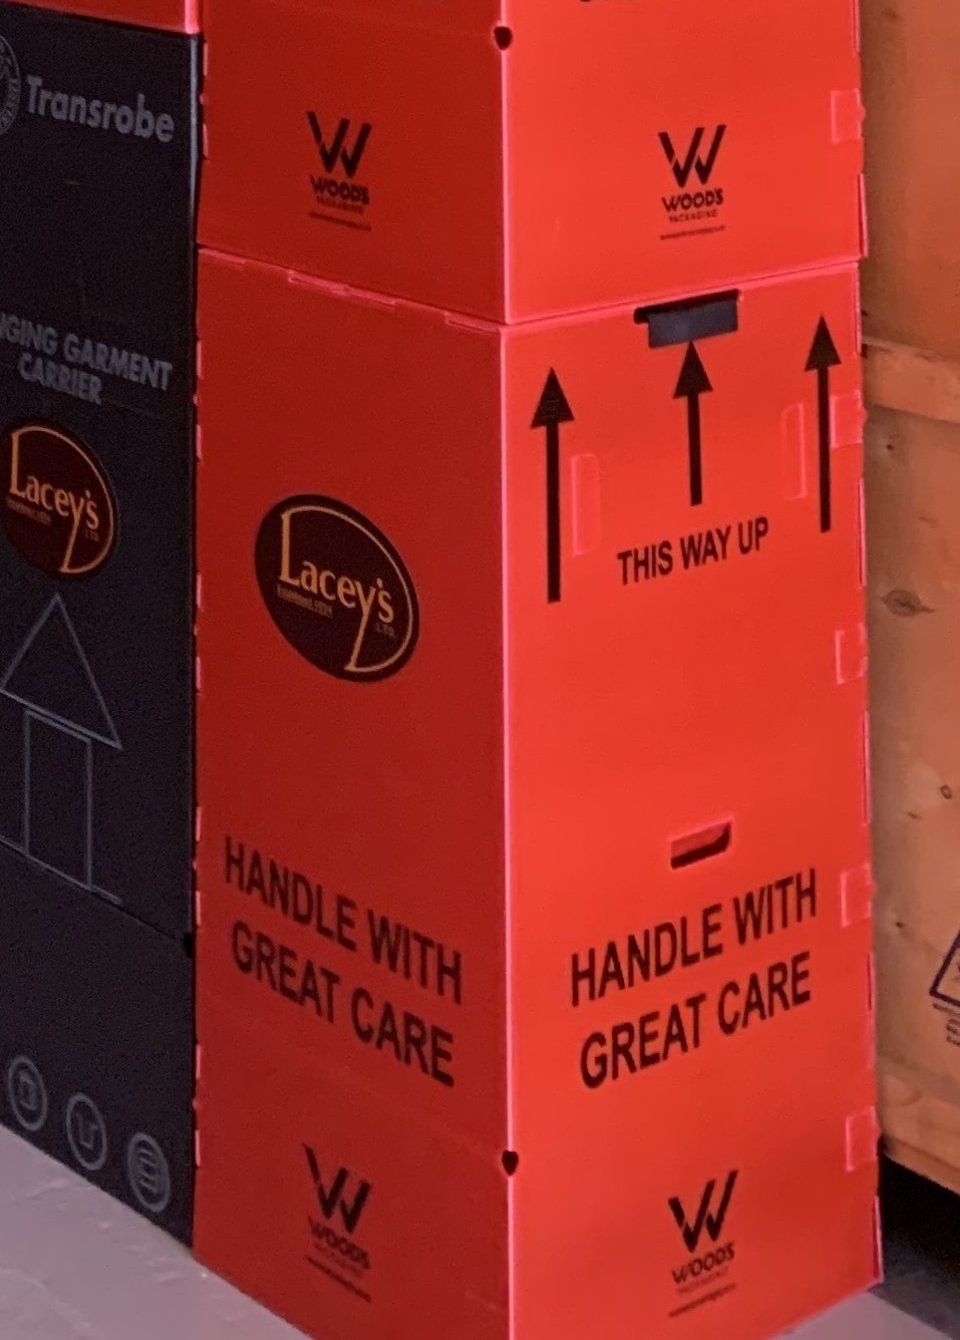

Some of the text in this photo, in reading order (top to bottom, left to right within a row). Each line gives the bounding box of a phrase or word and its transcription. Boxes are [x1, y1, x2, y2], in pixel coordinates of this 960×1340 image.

[27, 75, 175, 143] Transrobe
[18, 352, 103, 405] CARRIER
[63, 332, 173, 391] GARMENT
[617, 516, 768, 586] THIS WAY UP
[225, 835, 462, 1005] HANDLE WITH
[571, 868, 816, 1006] HANDLE WITH
[231, 921, 454, 1087] GREAT CARE
[580, 951, 811, 1088] GREAT CARE
